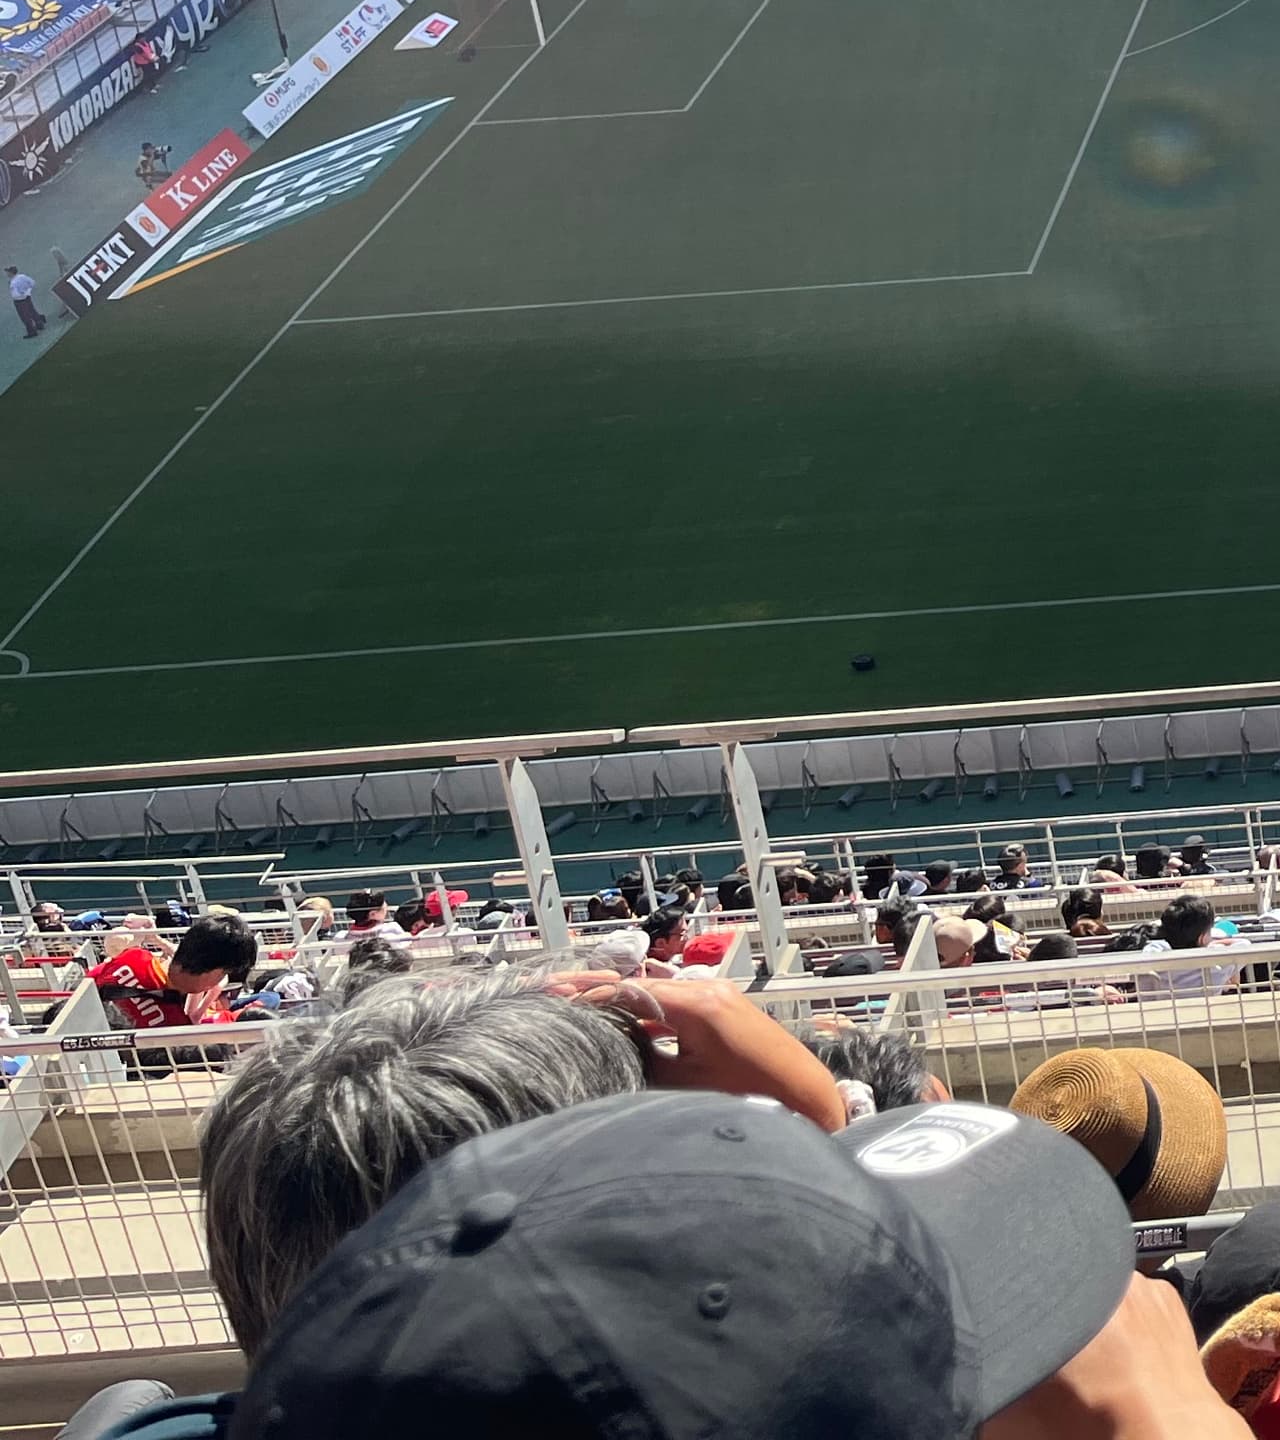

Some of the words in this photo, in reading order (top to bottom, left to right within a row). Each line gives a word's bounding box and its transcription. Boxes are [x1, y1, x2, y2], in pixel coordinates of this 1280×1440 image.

[274, 77, 297, 98] MUFG
[191, 147, 240, 198] LINE
[66, 231, 136, 308] JTEKT
